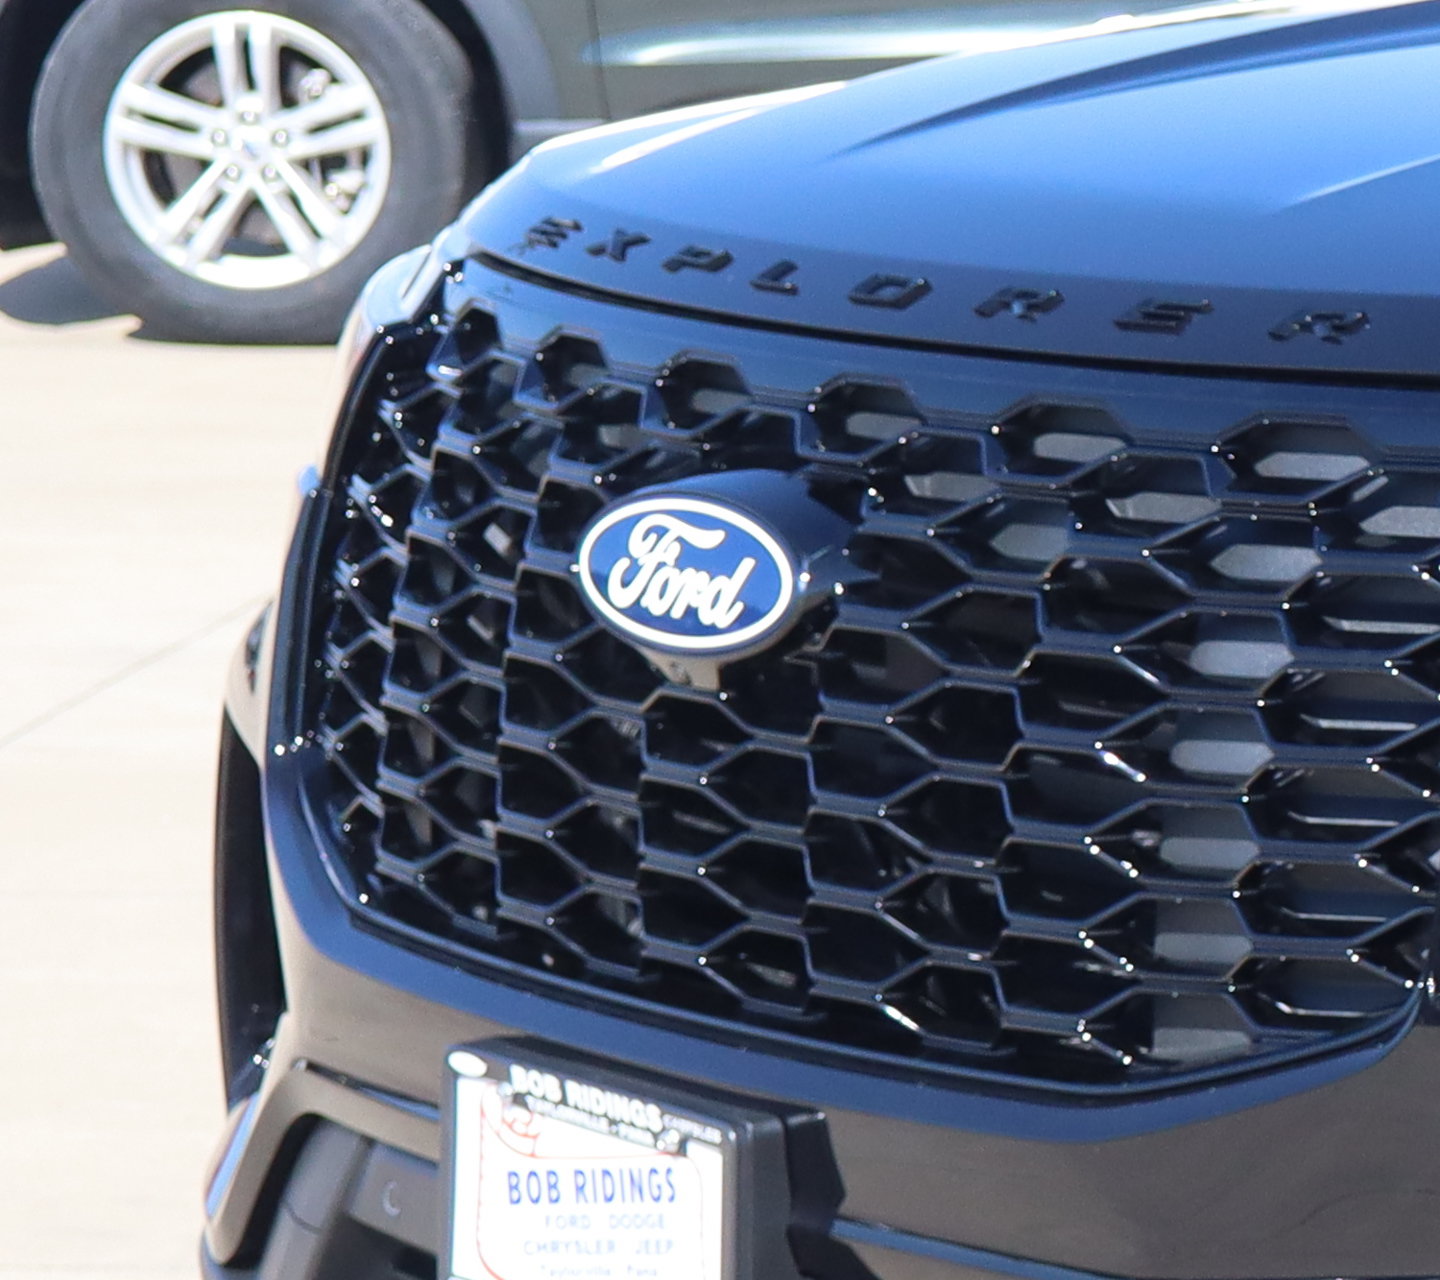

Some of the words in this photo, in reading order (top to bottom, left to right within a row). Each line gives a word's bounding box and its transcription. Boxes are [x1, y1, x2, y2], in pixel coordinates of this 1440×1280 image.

[518, 214, 1370, 347] EXPLORER
[607, 513, 756, 629] Ford
[509, 1063, 563, 1104] BOB
[564, 1078, 665, 1134] RIDINGS
[507, 1170, 561, 1206] BOB
[573, 1166, 677, 1205] RIDINGS
[522, 1238, 617, 1256] CHRYSLER
[634, 1238, 675, 1256] JEEP
[545, 1213, 591, 1231] FORD
[608, 1213, 666, 1231] DODGE
